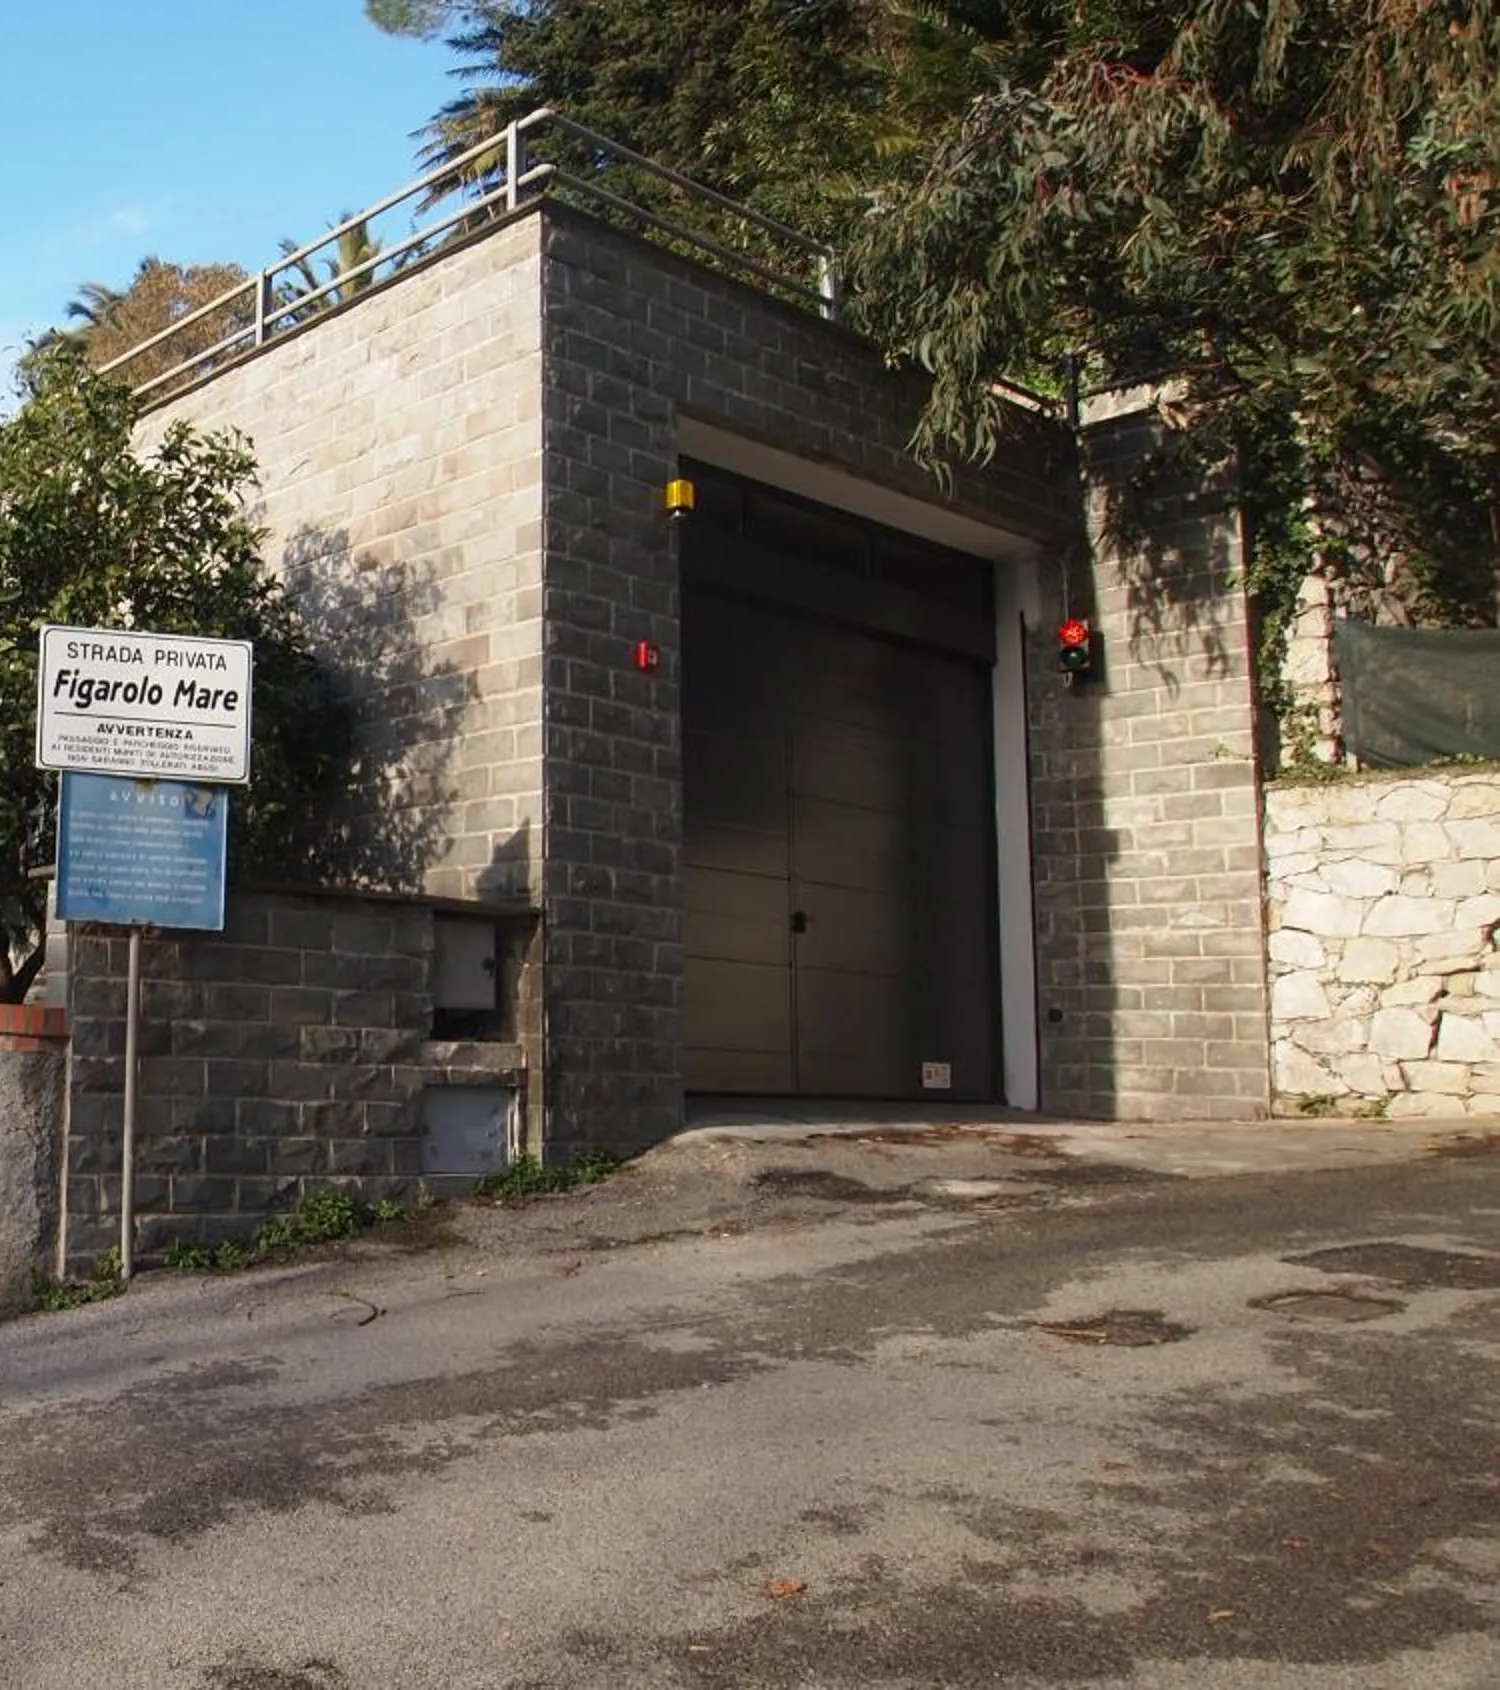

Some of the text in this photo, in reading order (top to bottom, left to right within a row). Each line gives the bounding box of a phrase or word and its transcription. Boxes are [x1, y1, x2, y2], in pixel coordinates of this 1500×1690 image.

[67, 642, 228, 671] STRADA PRIVATA
[53, 668, 239, 711] Figarolo Mare
[96, 723, 194, 740] AVVERTENZA
